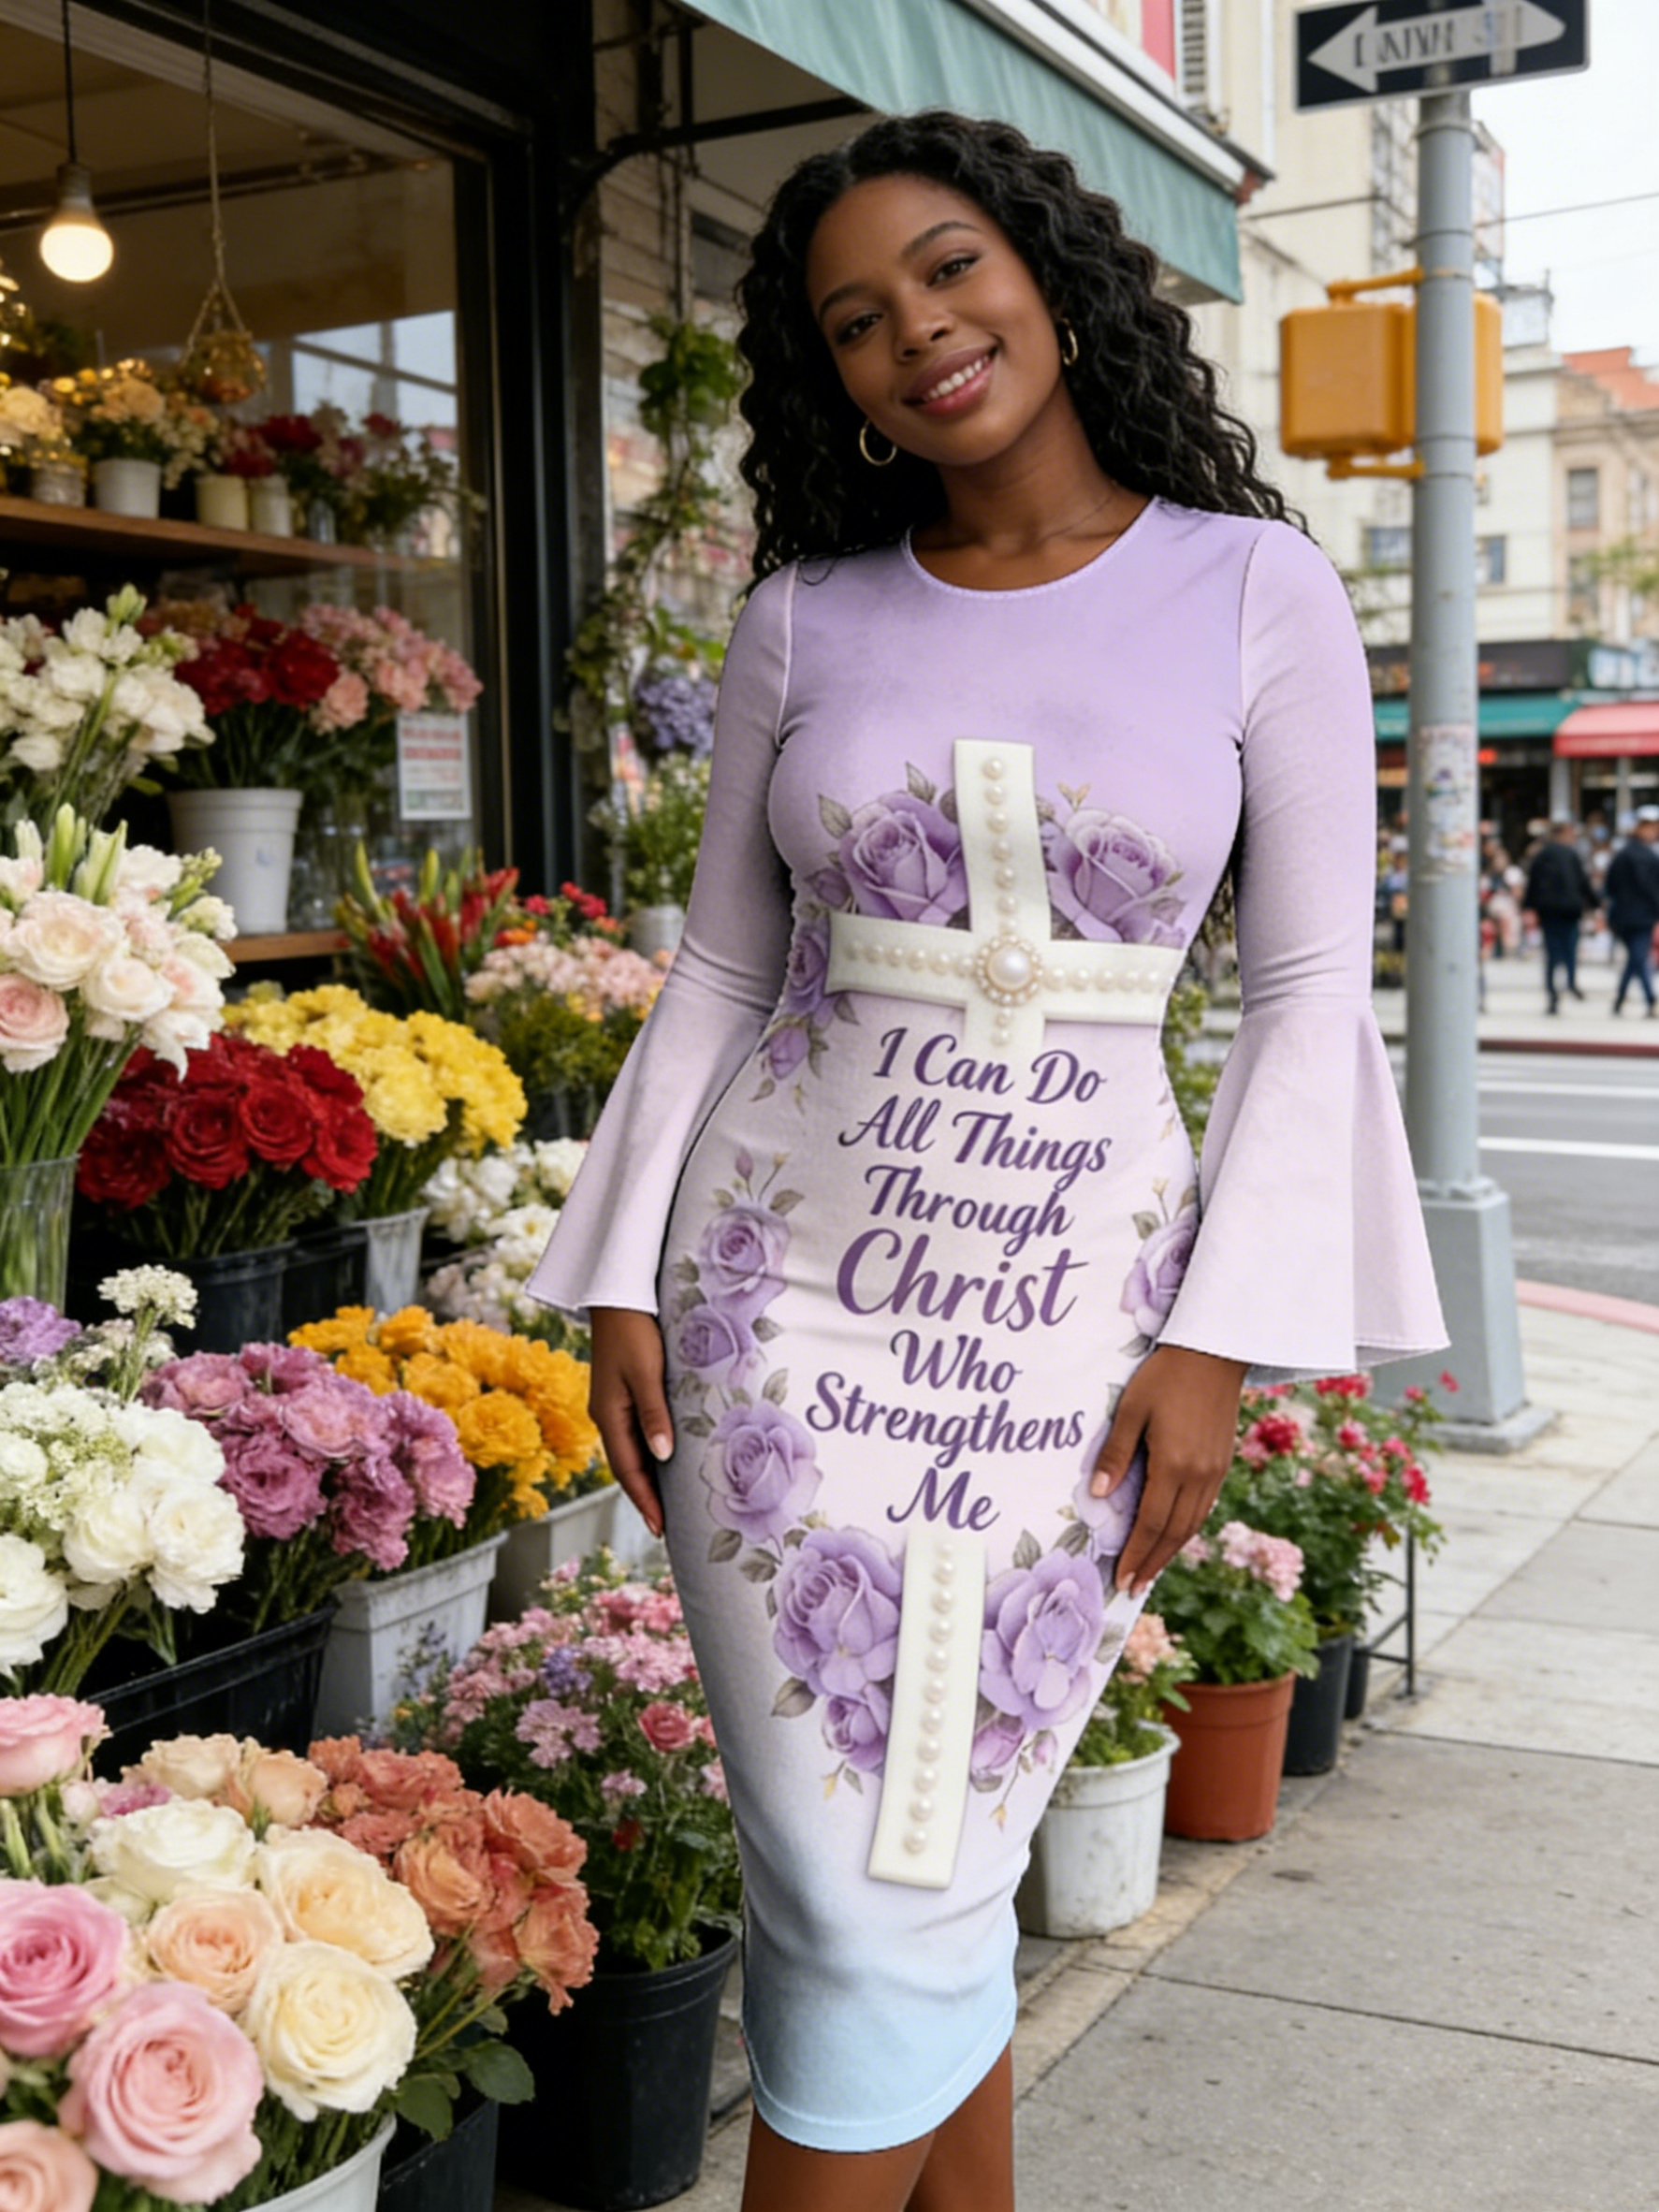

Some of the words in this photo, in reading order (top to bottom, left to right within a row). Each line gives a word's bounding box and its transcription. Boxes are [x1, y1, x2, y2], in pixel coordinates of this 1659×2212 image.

[871, 1026, 908, 1078] I
[913, 1034, 1014, 1096] Can
[1026, 1049, 1107, 1104] Do
[838, 1095, 941, 1154] All
[952, 1111, 1112, 1191] Things
[865, 1164, 1075, 1257] Through
[836, 1228, 1089, 1332] Christ
[890, 1330, 1023, 1393] Who
[806, 1372, 1084, 1469] Strengthens
[887, 1467, 1000, 1531] Me
